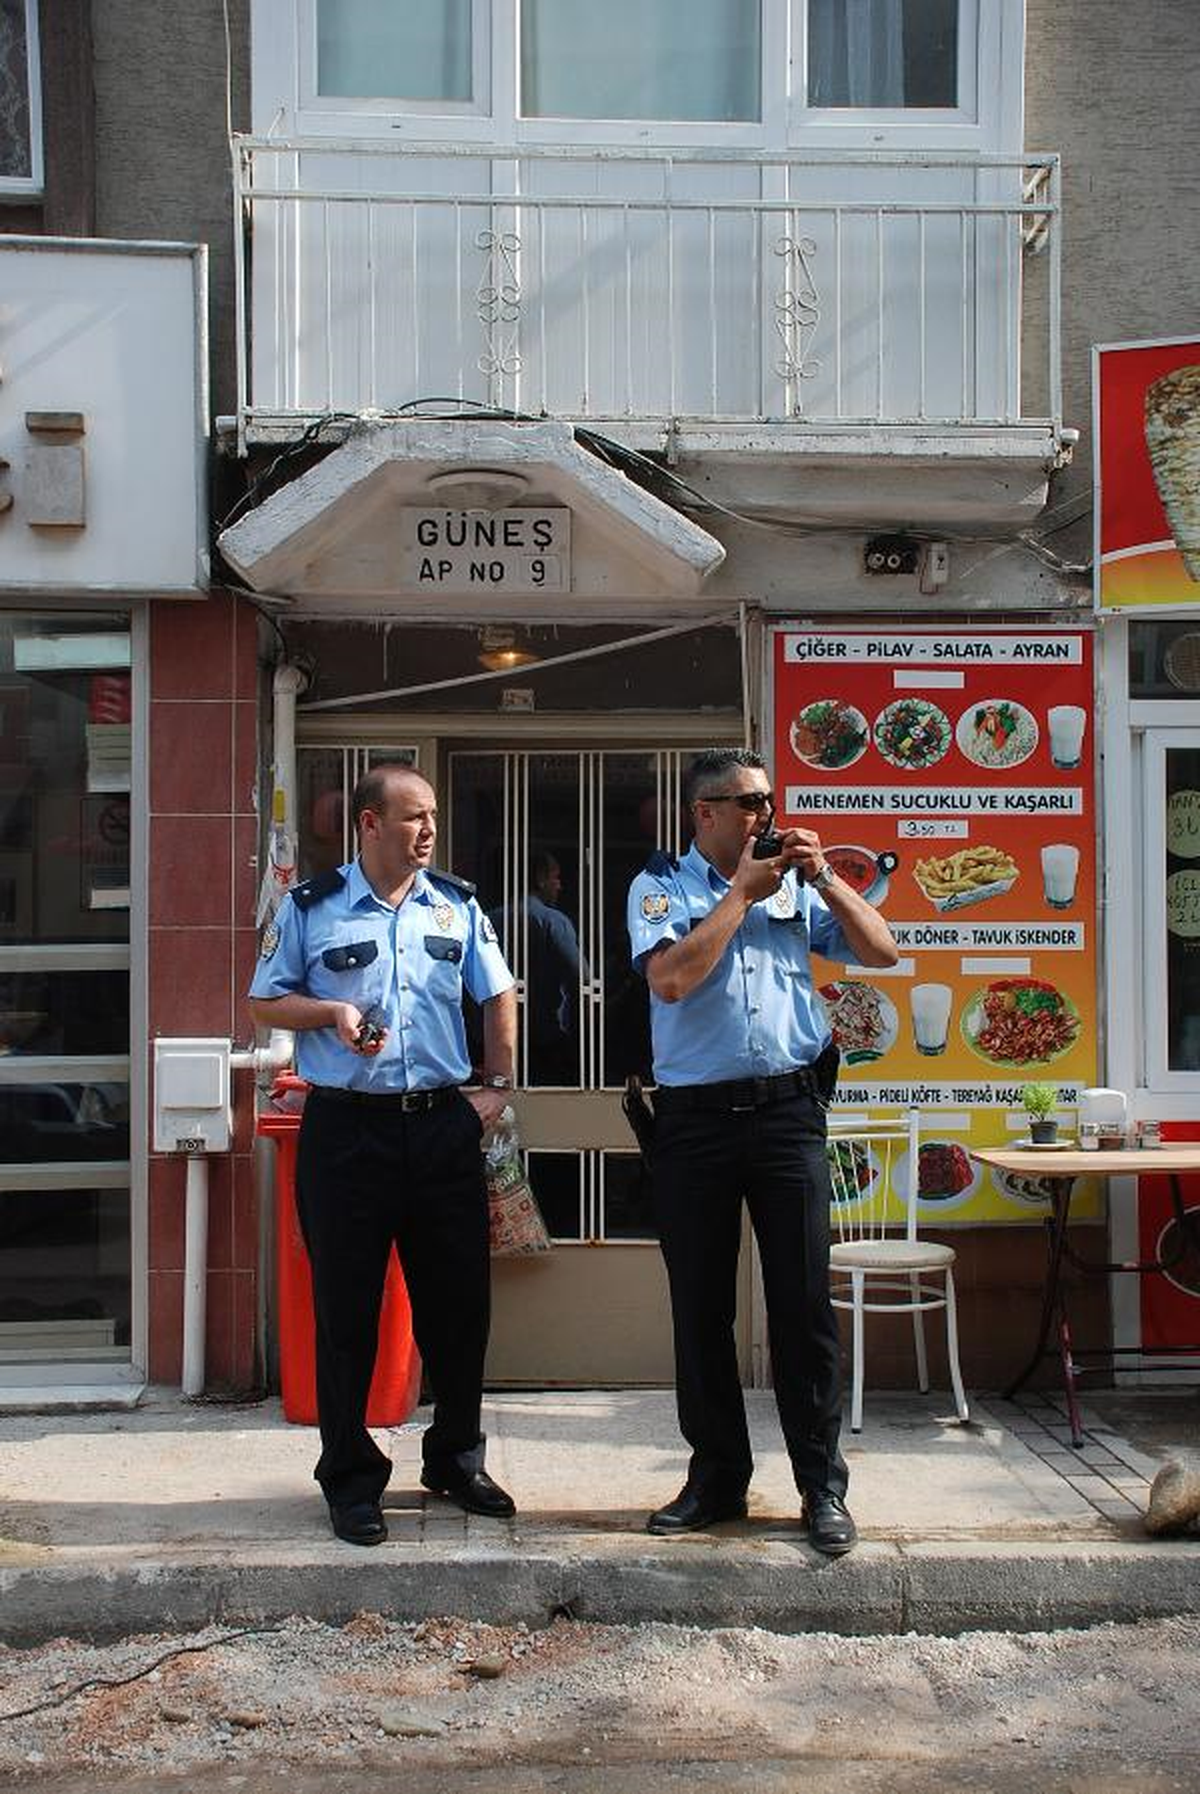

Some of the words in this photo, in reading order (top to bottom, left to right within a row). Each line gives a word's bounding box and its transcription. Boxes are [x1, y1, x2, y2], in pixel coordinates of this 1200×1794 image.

[417, 512, 553, 552] GÜNEŞ
[419, 557, 453, 582] AP
[470, 561, 505, 582] NO
[531, 559, 546, 587] 9
[796, 637, 847, 660] ÇİĞER
[932, 643, 994, 658] SALATA
[1012, 643, 1069, 658] AYRAN
[796, 794, 885, 809] MENEMEN
[890, 794, 972, 809] SUCUKLU
[977, 795, 999, 809] VE
[1004, 795, 1073, 812] KAŞARLI
[915, 926, 959, 945] DÖNER
[972, 929, 1014, 945] TAVUK
